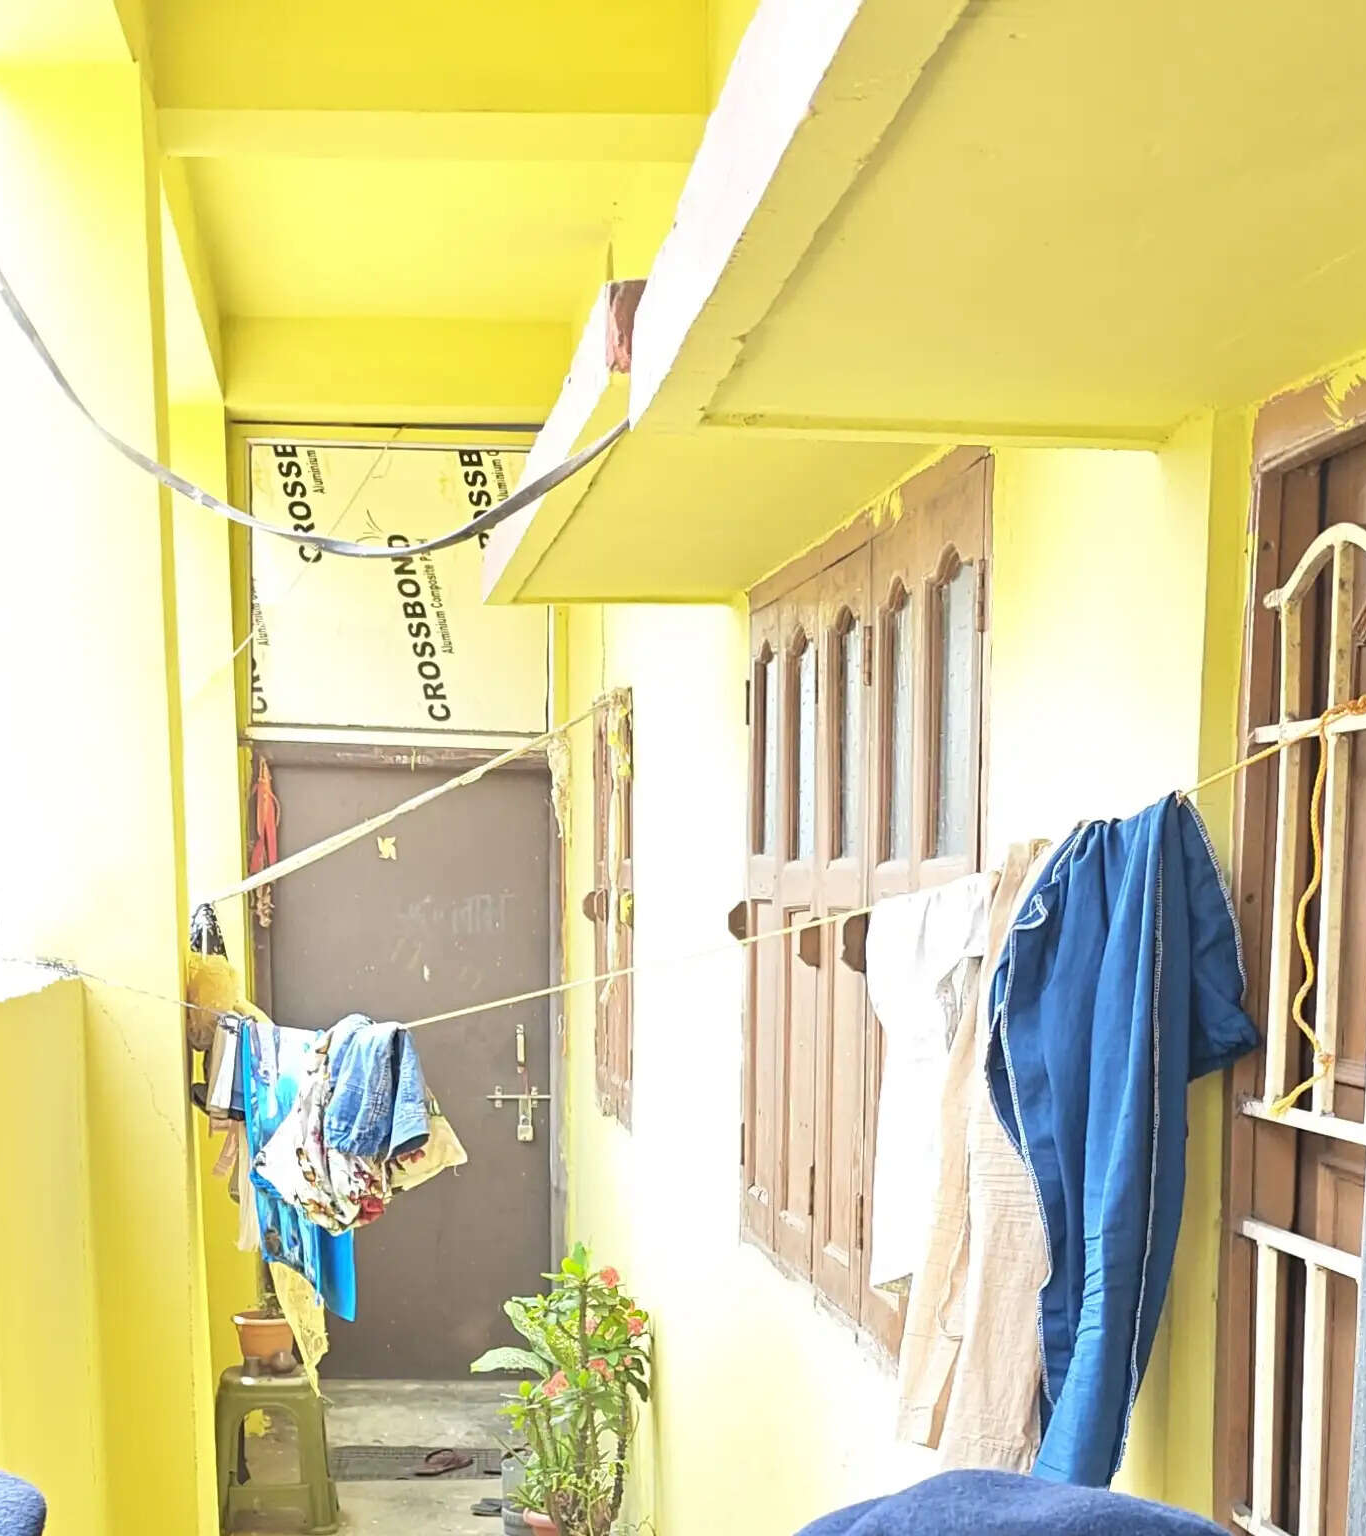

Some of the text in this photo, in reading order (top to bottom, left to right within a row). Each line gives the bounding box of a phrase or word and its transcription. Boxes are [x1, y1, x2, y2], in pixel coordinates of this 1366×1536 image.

[423, 564, 443, 608] Composite
[387, 534, 451, 721] CROSSBOND
[436, 610, 454, 654] Aluminium
